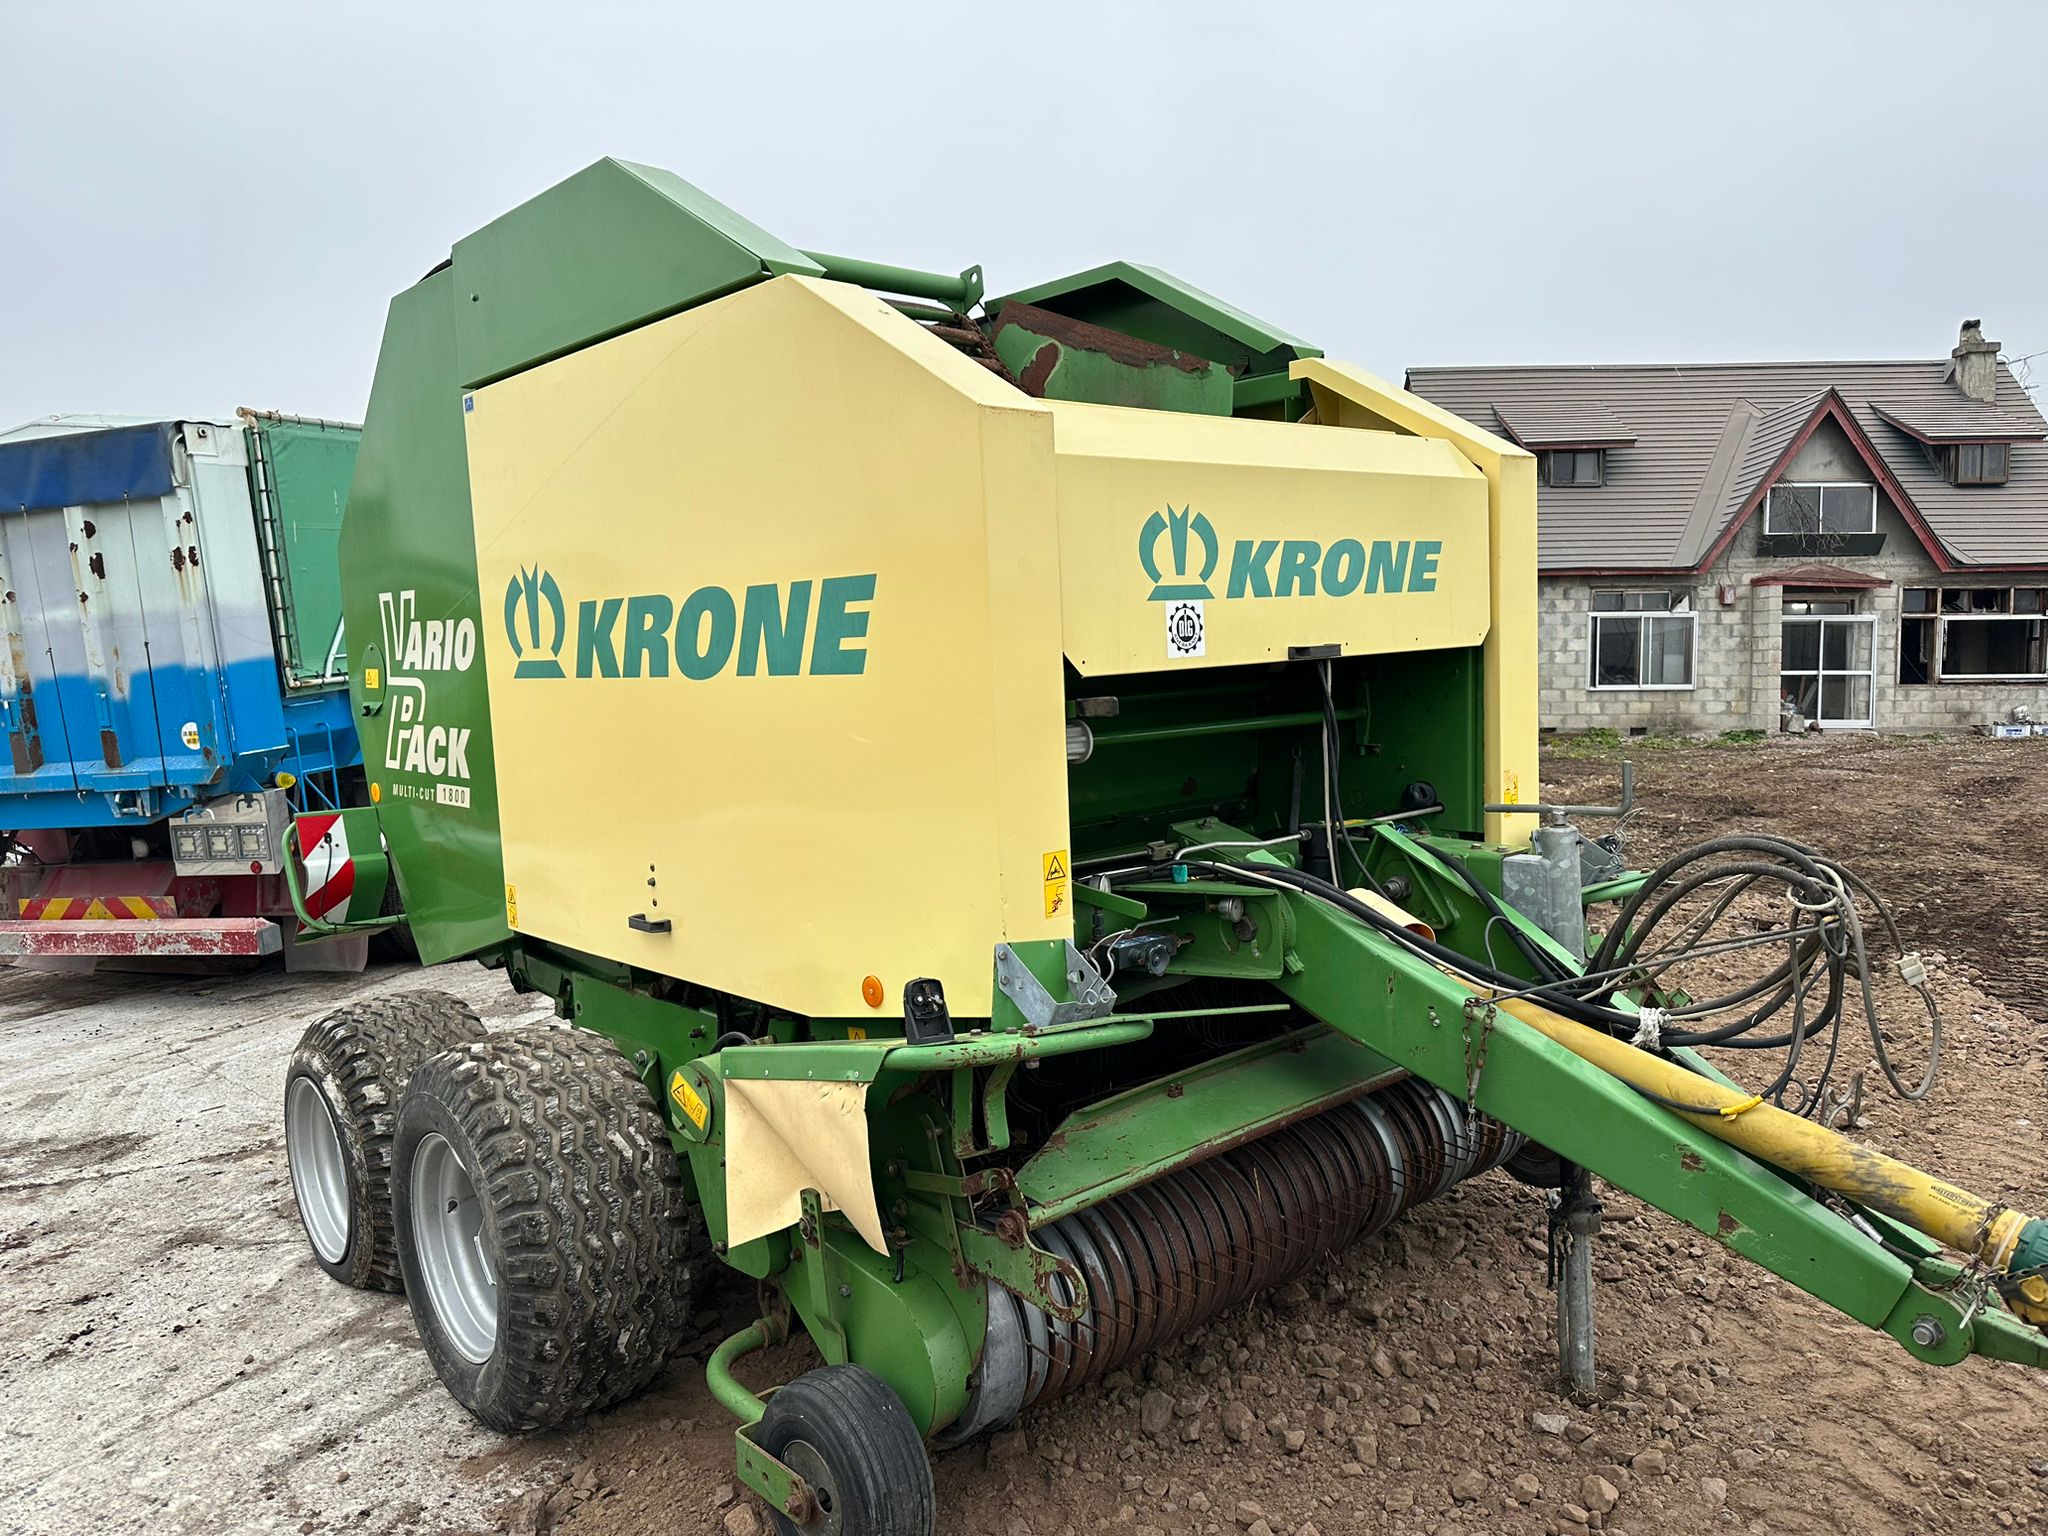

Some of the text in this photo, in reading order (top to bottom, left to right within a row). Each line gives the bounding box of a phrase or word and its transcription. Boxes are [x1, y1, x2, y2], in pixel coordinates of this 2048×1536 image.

[1226, 538, 1443, 599] KRONE
[379, 590, 476, 672] VARIO
[576, 573, 877, 681] KRONE
[385, 677, 471, 779] PACK
[392, 783, 466, 804] MULTI-CUT 1800
